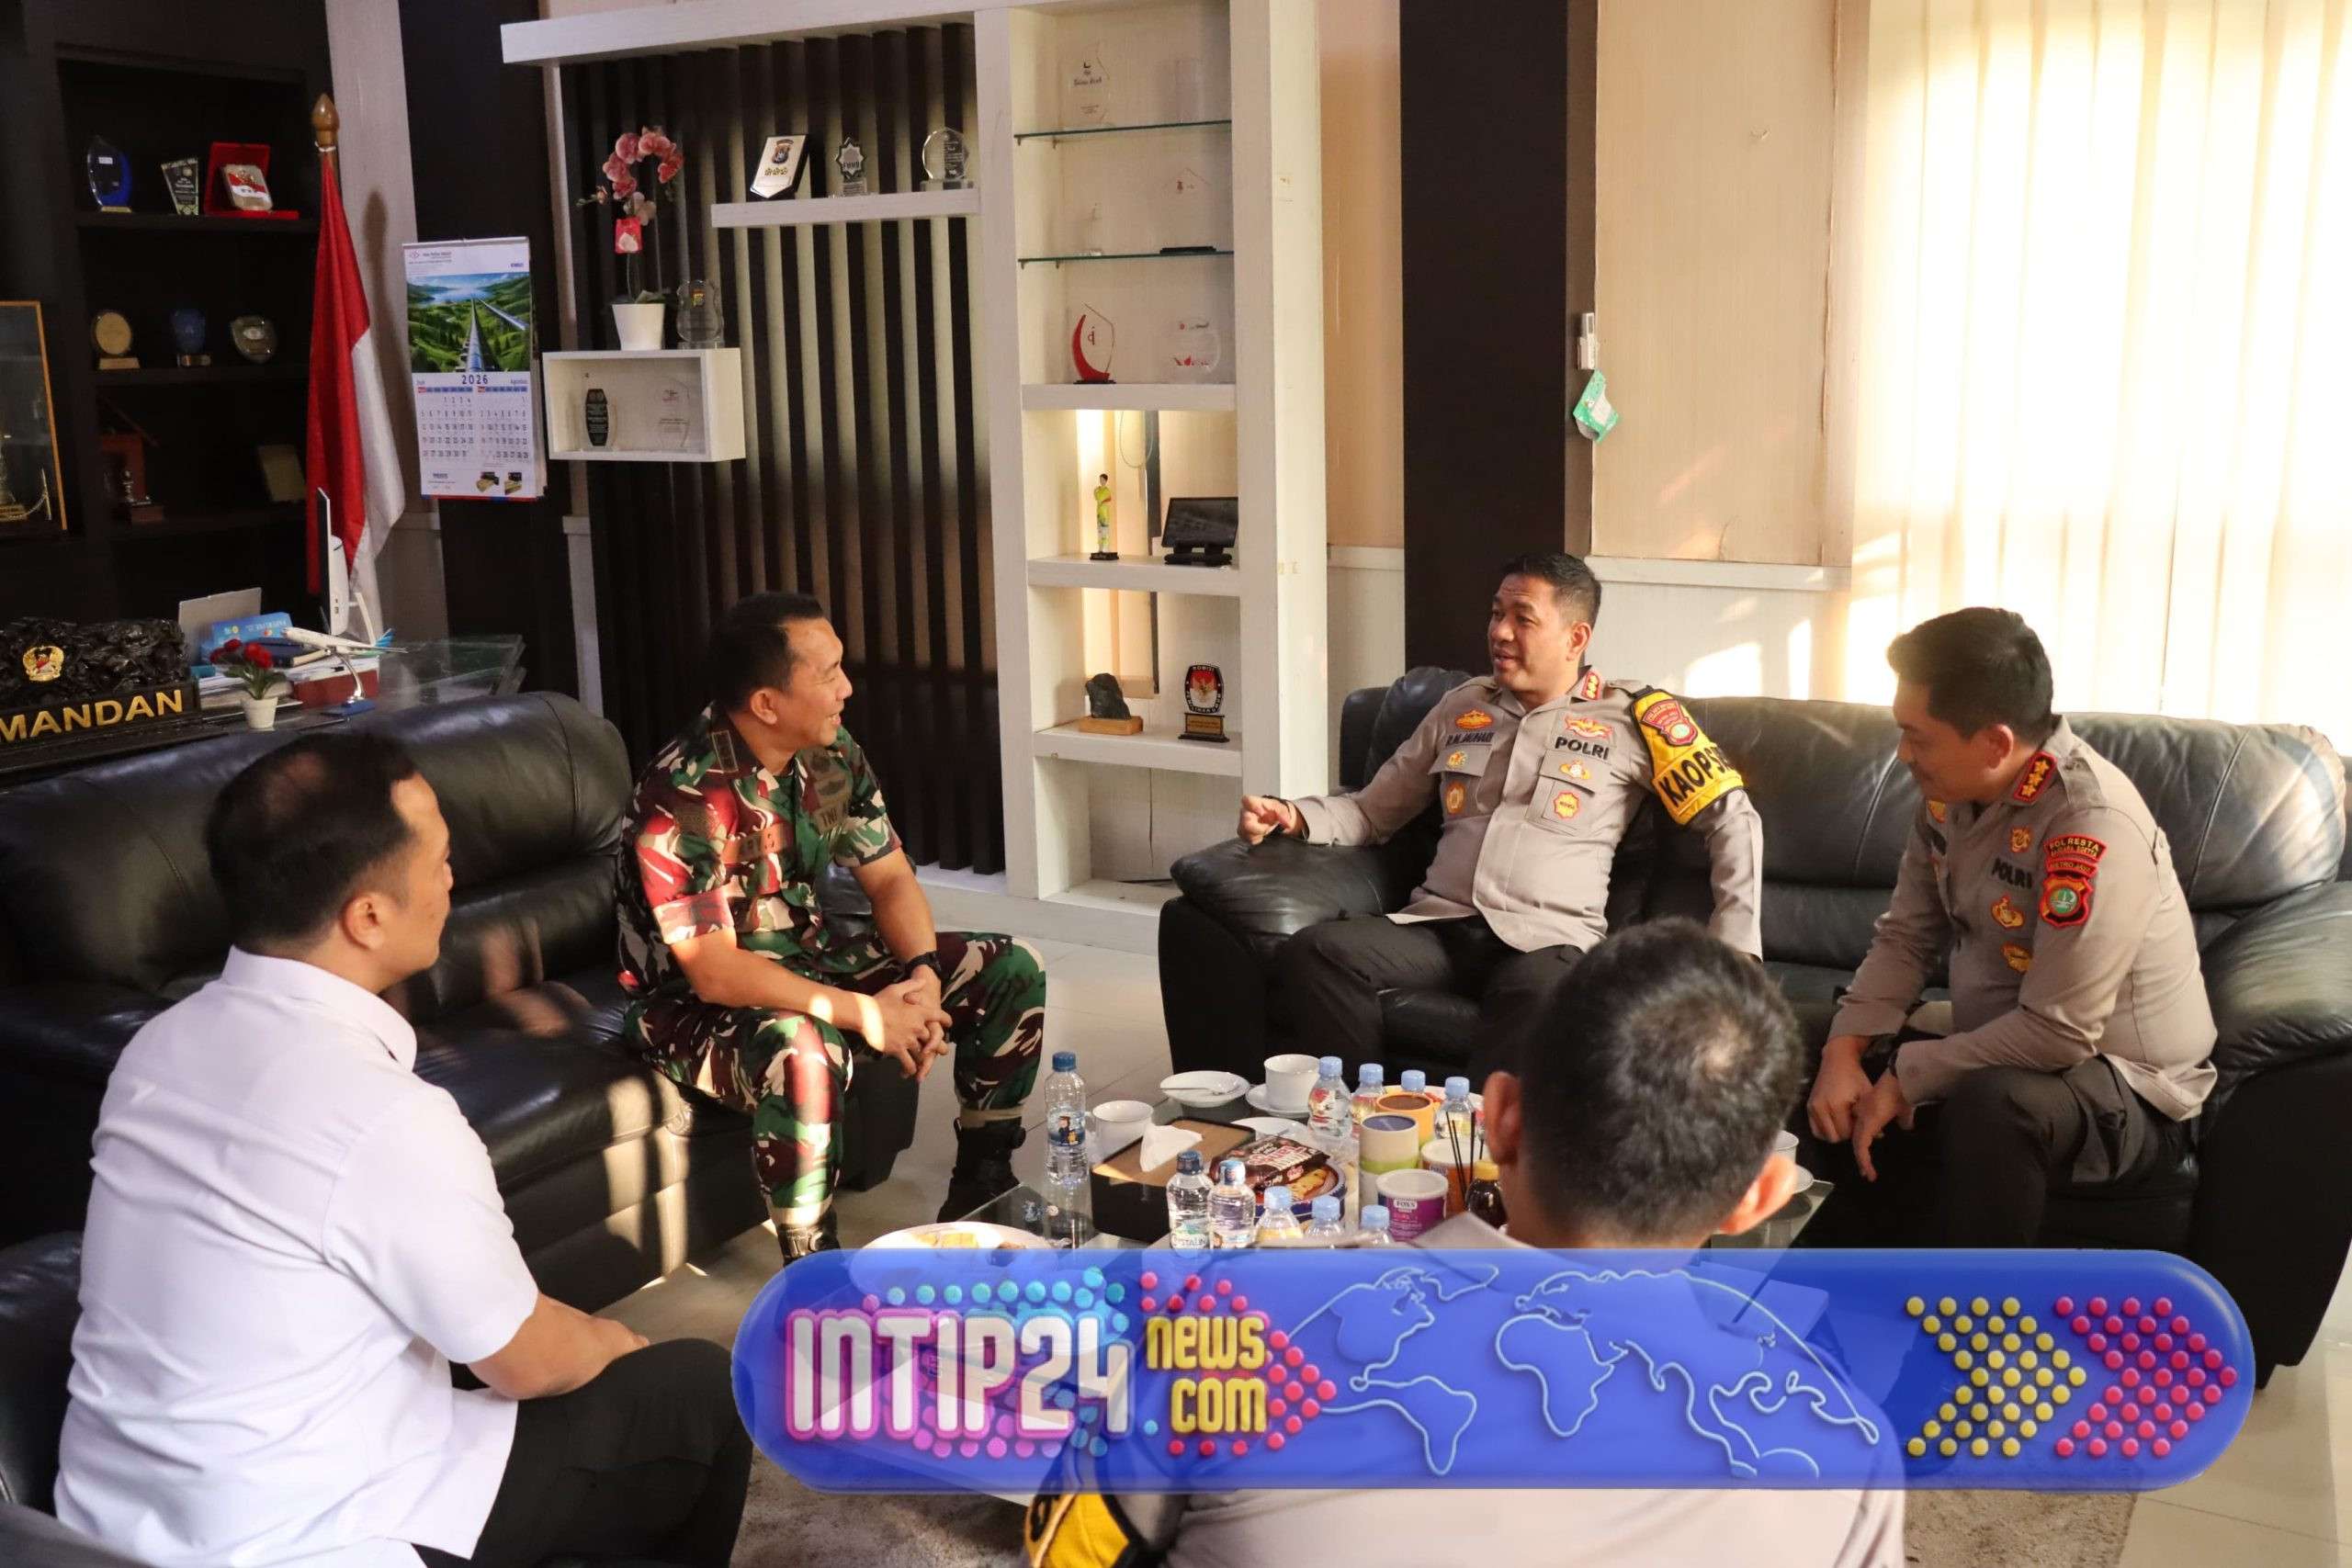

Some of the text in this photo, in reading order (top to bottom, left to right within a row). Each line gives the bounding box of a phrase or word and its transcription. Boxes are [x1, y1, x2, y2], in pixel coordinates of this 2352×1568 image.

[461, 375, 489, 385] 2026
[1555, 737, 1609, 761] POLRI
[1992, 857, 2033, 889] POLRI
